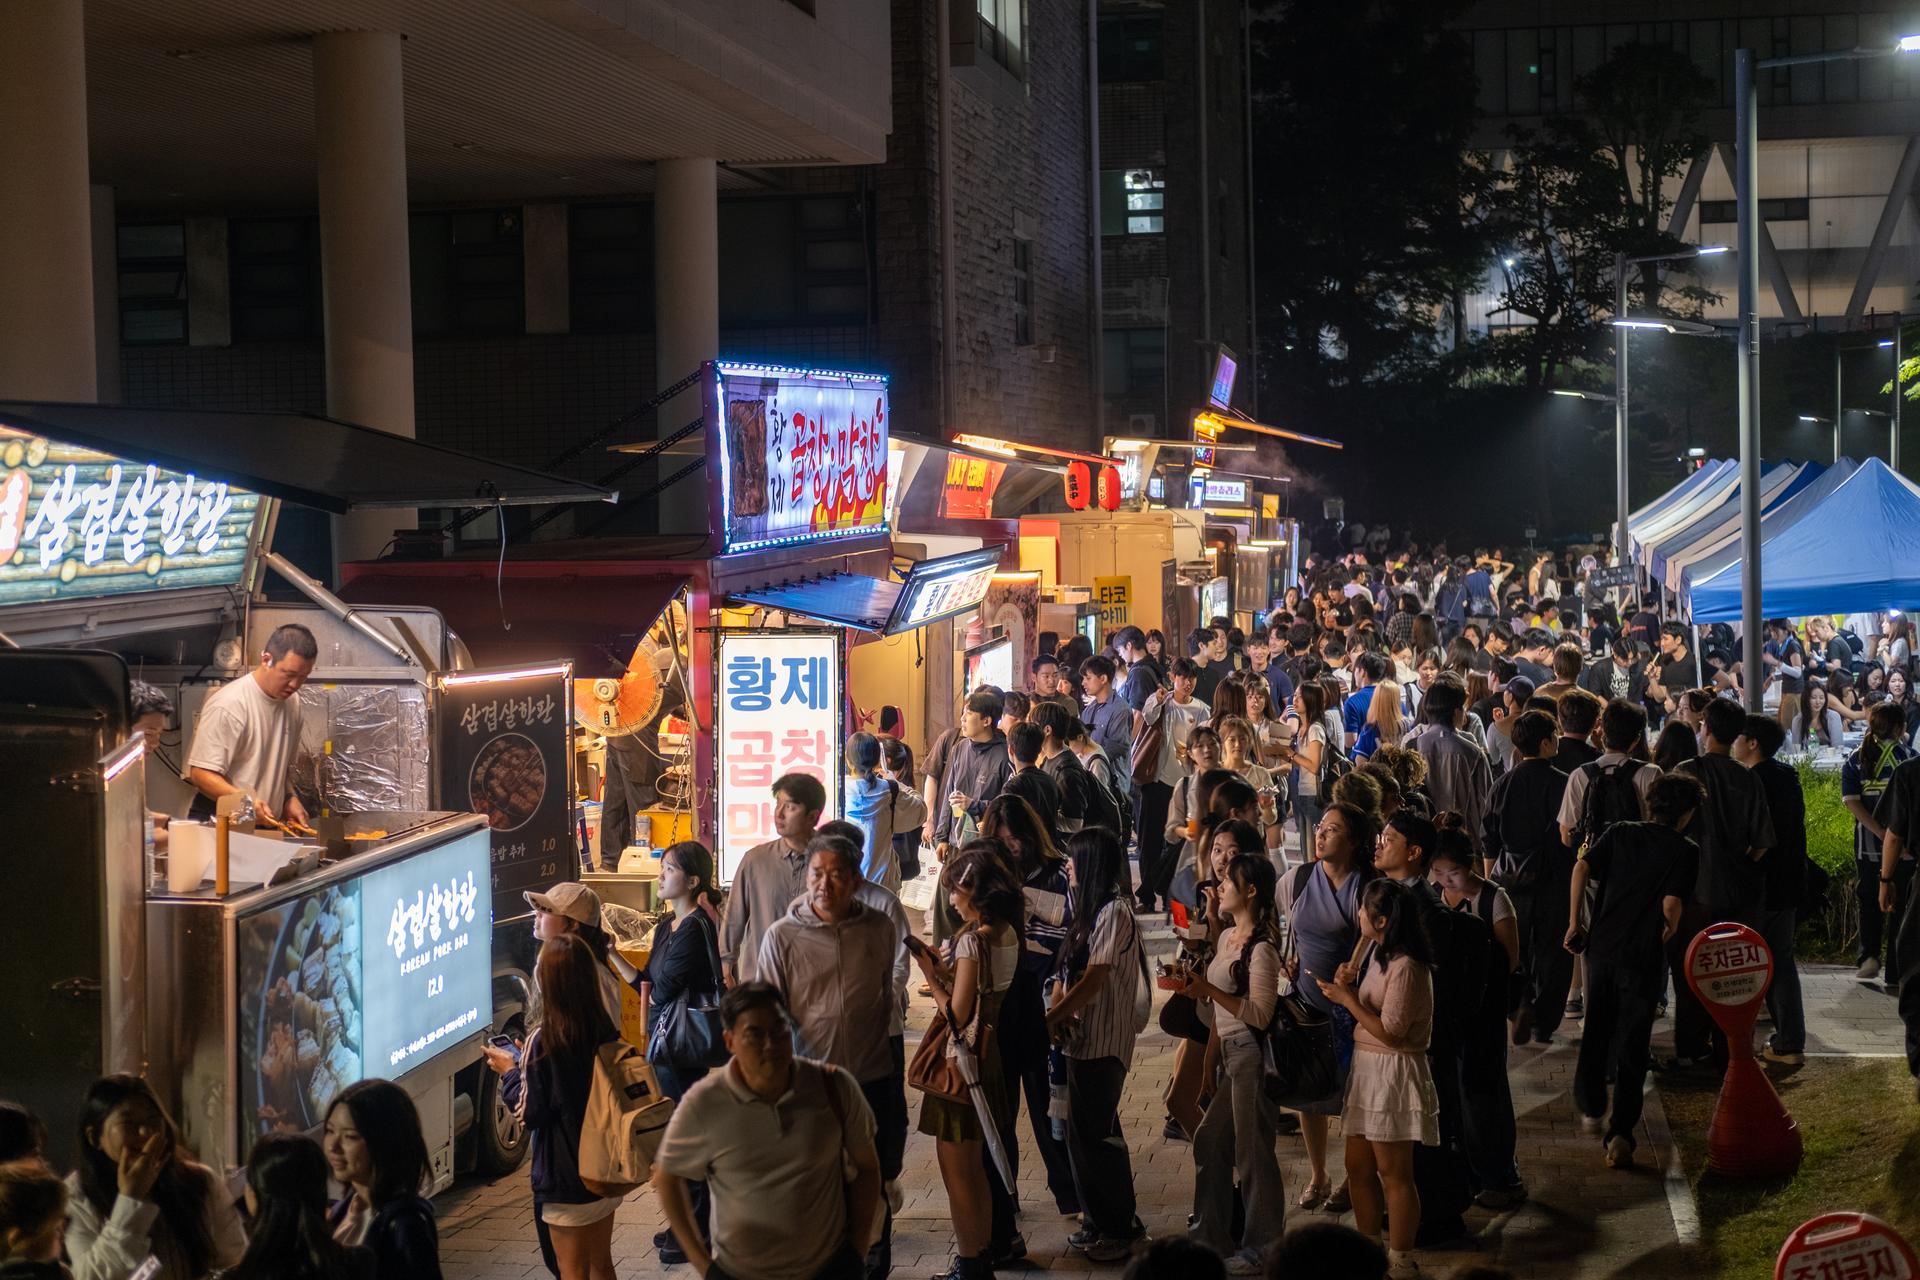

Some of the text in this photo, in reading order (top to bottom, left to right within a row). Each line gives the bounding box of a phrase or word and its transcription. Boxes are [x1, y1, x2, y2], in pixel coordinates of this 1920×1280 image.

[770, 398, 787, 514] 황제
[25, 464, 232, 570] 삼겹살한판
[1101, 586, 1126, 604] 타코
[1102, 606, 1127, 624] 야끼
[727, 656, 828, 711] 황제
[460, 694, 555, 735] 삼겹살한판
[726, 729, 831, 787] 곱창
[509, 842, 527, 859] 추가
[542, 837, 556, 852] 1.0
[540, 862, 556, 877] 2.0
[387, 871, 477, 958] 삼겹살한판
[401, 950, 430, 976] KOREAN
[433, 941, 452, 961] PORK
[1698, 944, 1760, 972] 주차금지
